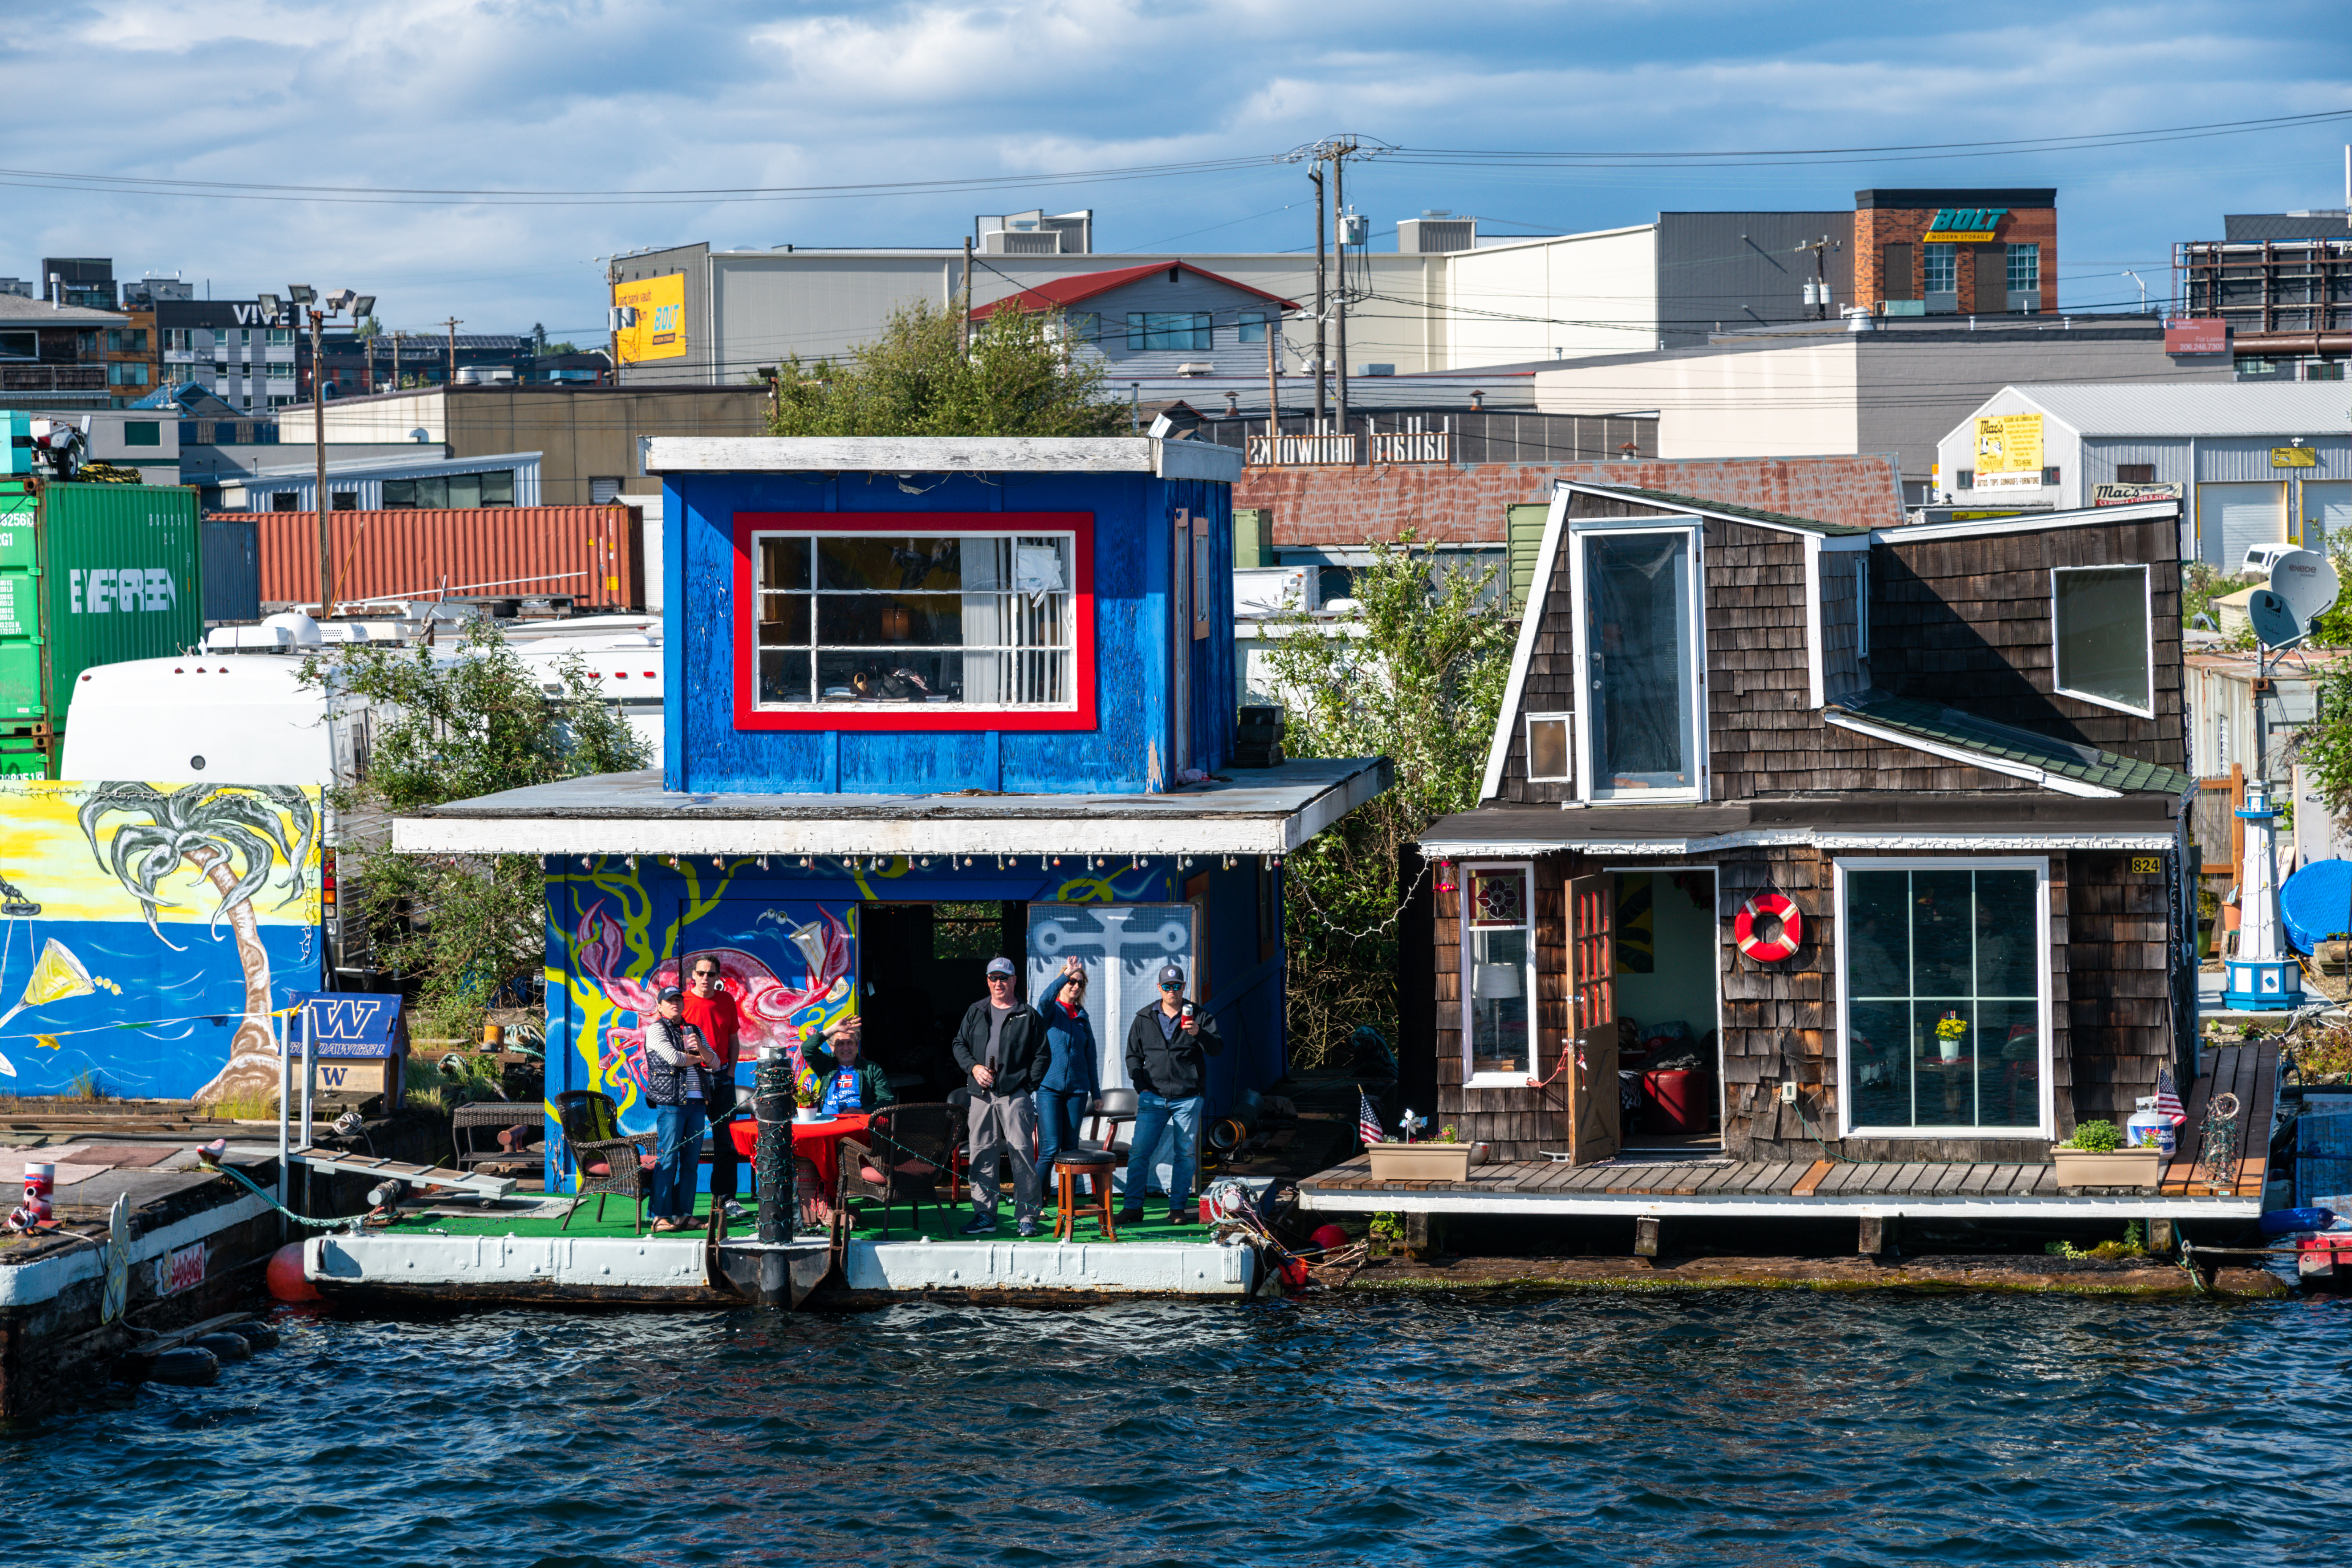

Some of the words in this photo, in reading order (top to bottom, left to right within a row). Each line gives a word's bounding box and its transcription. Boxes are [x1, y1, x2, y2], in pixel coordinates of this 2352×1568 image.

[1930, 209, 2008, 230] BOLT
[629, 291, 639, 304] bank
[640, 289, 651, 302] vault
[654, 304, 680, 332] BOLT
[1981, 420, 2003, 434] Mac's
[2096, 485, 2139, 498] Mac's
[0, 533, 13, 546] G1
[70, 569, 176, 613] EVERGREEN
[2264, 608, 2281, 618] DIRECTV
[2134, 860, 2159, 871] 824
[308, 999, 380, 1038] W
[321, 1067, 348, 1086] W
